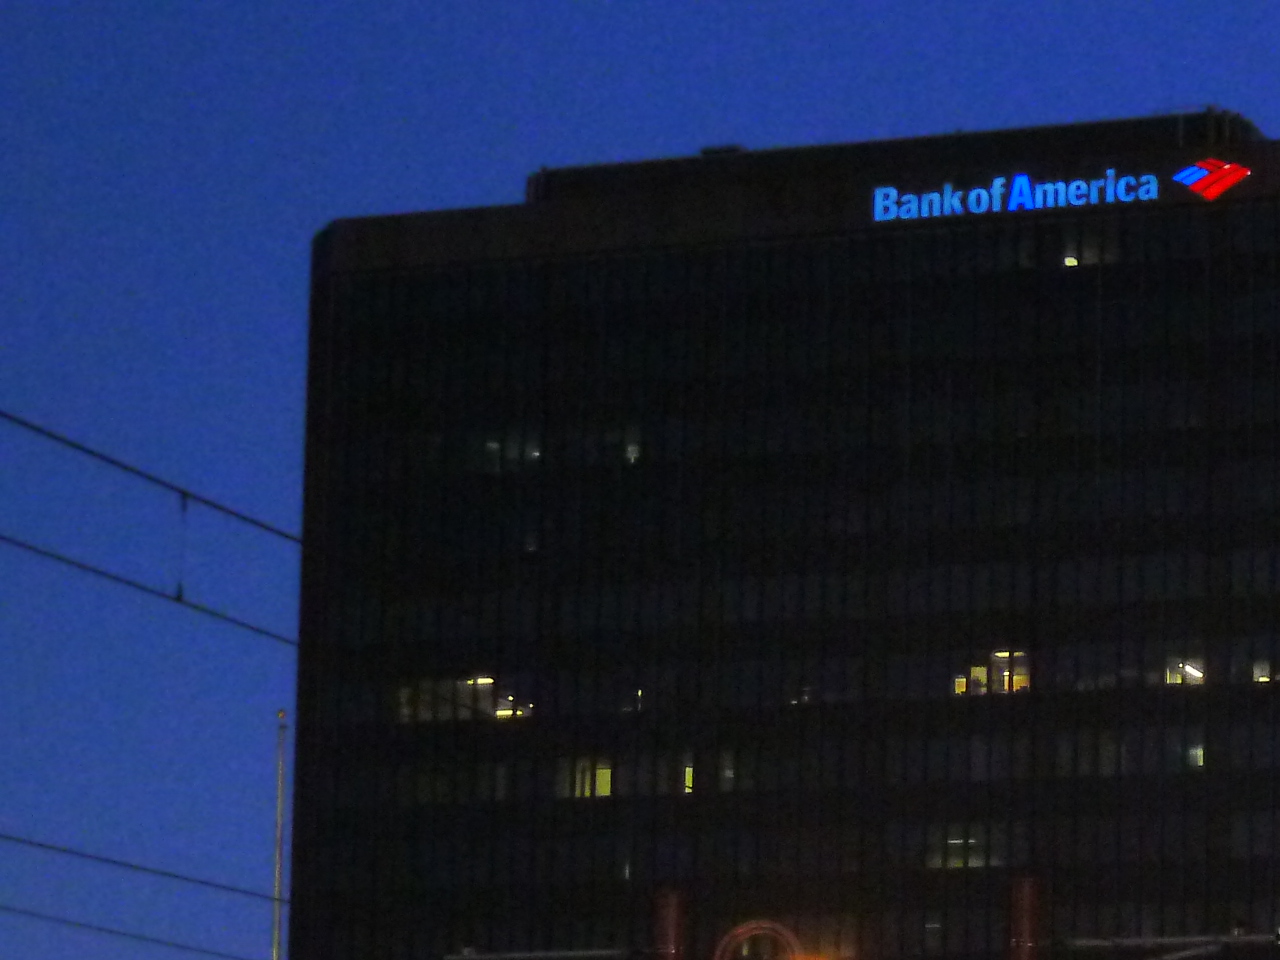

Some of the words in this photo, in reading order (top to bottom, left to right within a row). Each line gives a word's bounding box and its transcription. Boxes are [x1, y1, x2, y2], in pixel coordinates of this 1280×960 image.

[874, 183, 964, 222] Bank
[967, 176, 1006, 214] of
[1007, 169, 1158, 211] America
